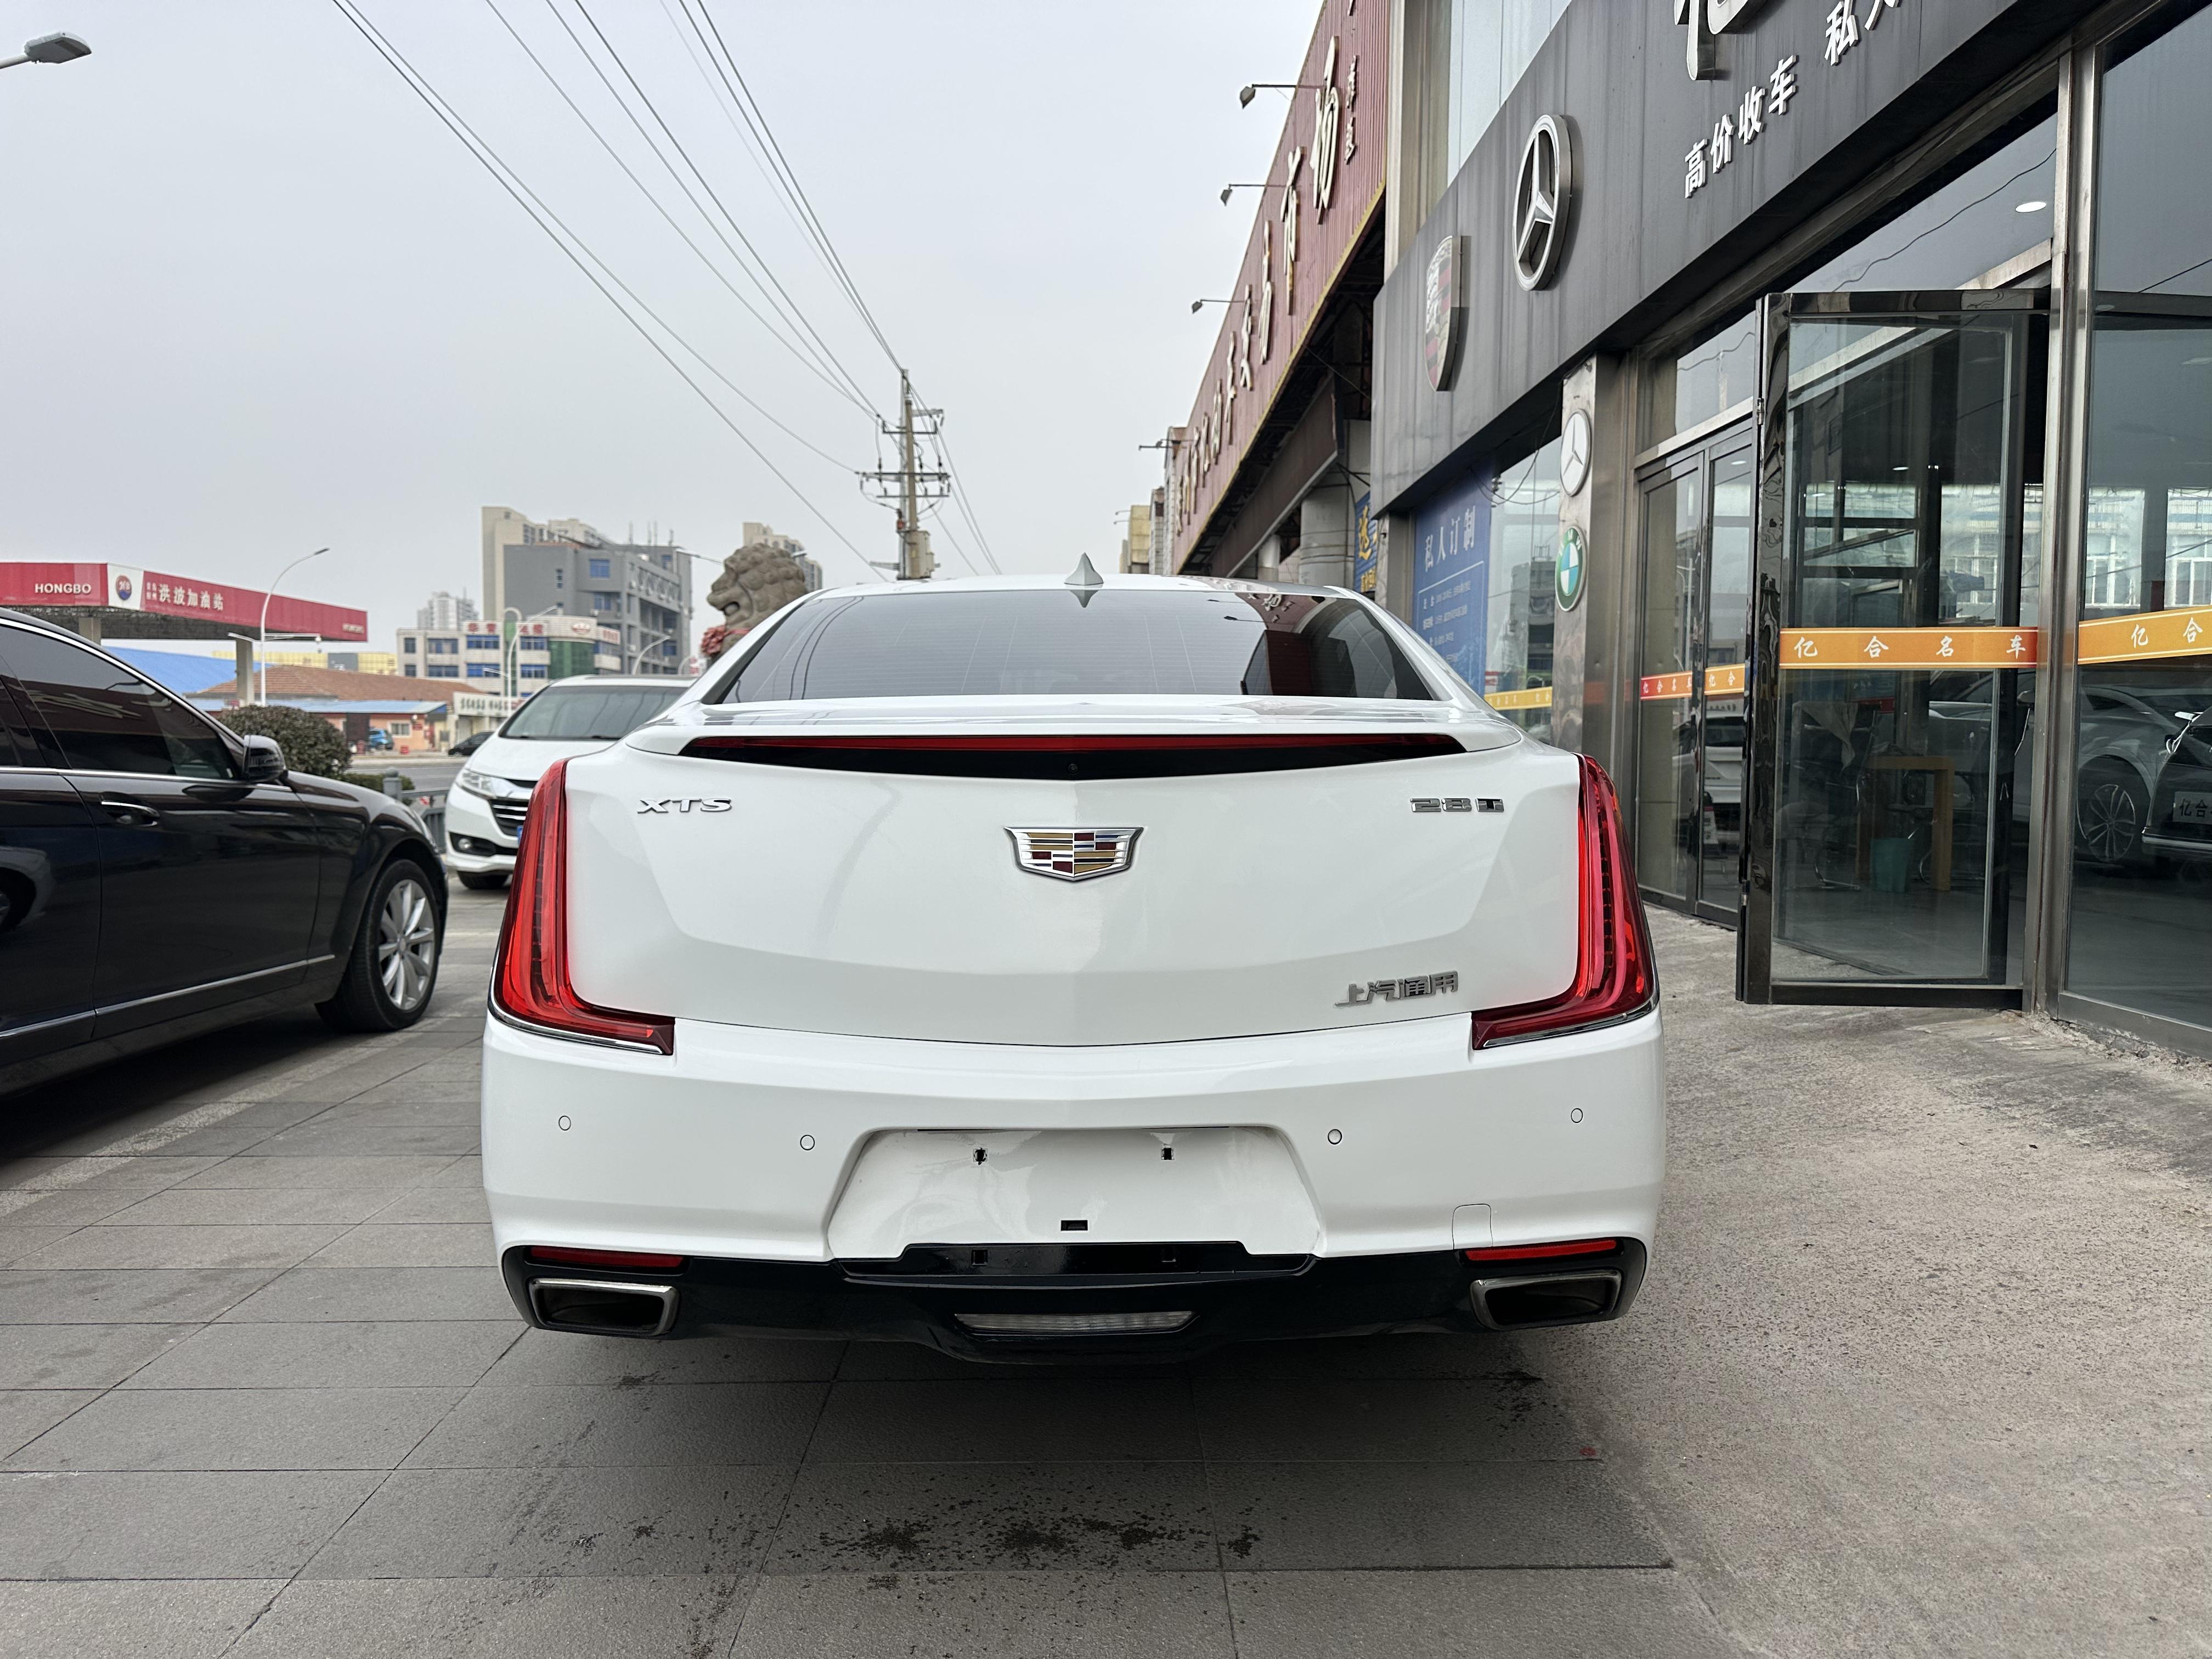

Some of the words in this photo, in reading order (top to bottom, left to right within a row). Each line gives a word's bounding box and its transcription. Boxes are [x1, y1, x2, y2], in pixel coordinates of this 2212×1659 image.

[1685, 55, 1798, 198] 高价收车
[1425, 506, 1476, 572] 私人订制
[35, 583, 92, 594] HONGBO
[2131, 617, 2203, 648] 亿合
[1793, 635, 2025, 659] 亿合名车
[1708, 670, 1736, 687] 亿合
[637, 798, 732, 814] XTS
[1410, 798, 1504, 812] 28T
[2179, 798, 2212, 818] 亿合
[1335, 970, 1459, 1006] 上汽通用
